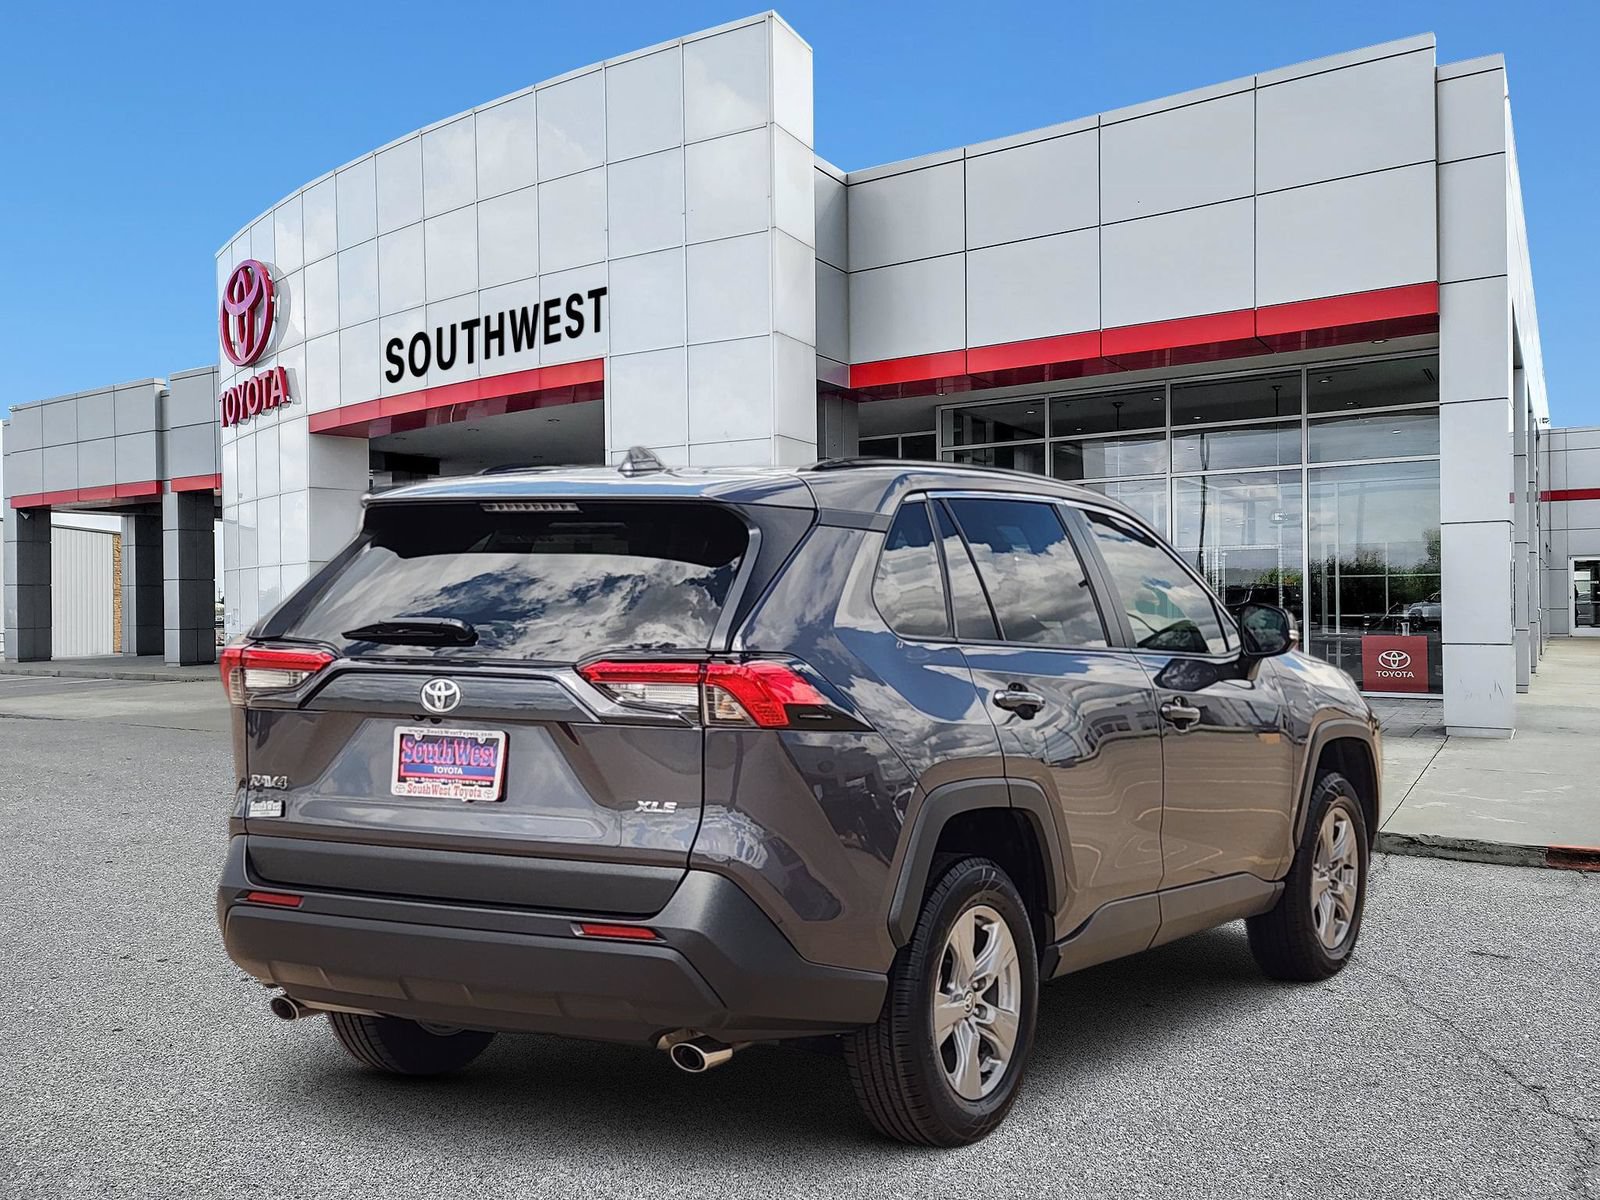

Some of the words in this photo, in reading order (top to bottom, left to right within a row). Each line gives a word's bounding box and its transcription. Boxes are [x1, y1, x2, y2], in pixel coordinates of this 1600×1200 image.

[385, 287, 608, 383] SOUTHWEST
[219, 366, 288, 427] TOYOTA
[1376, 670, 1414, 678] TOYOTA
[402, 736, 497, 766] SouthWest
[433, 766, 463, 775] TOYOTA
[250, 774, 288, 789] RAV4
[407, 783, 451, 795] SouthWest
[453, 785, 482, 798] Toyota
[635, 800, 678, 813] XLE
